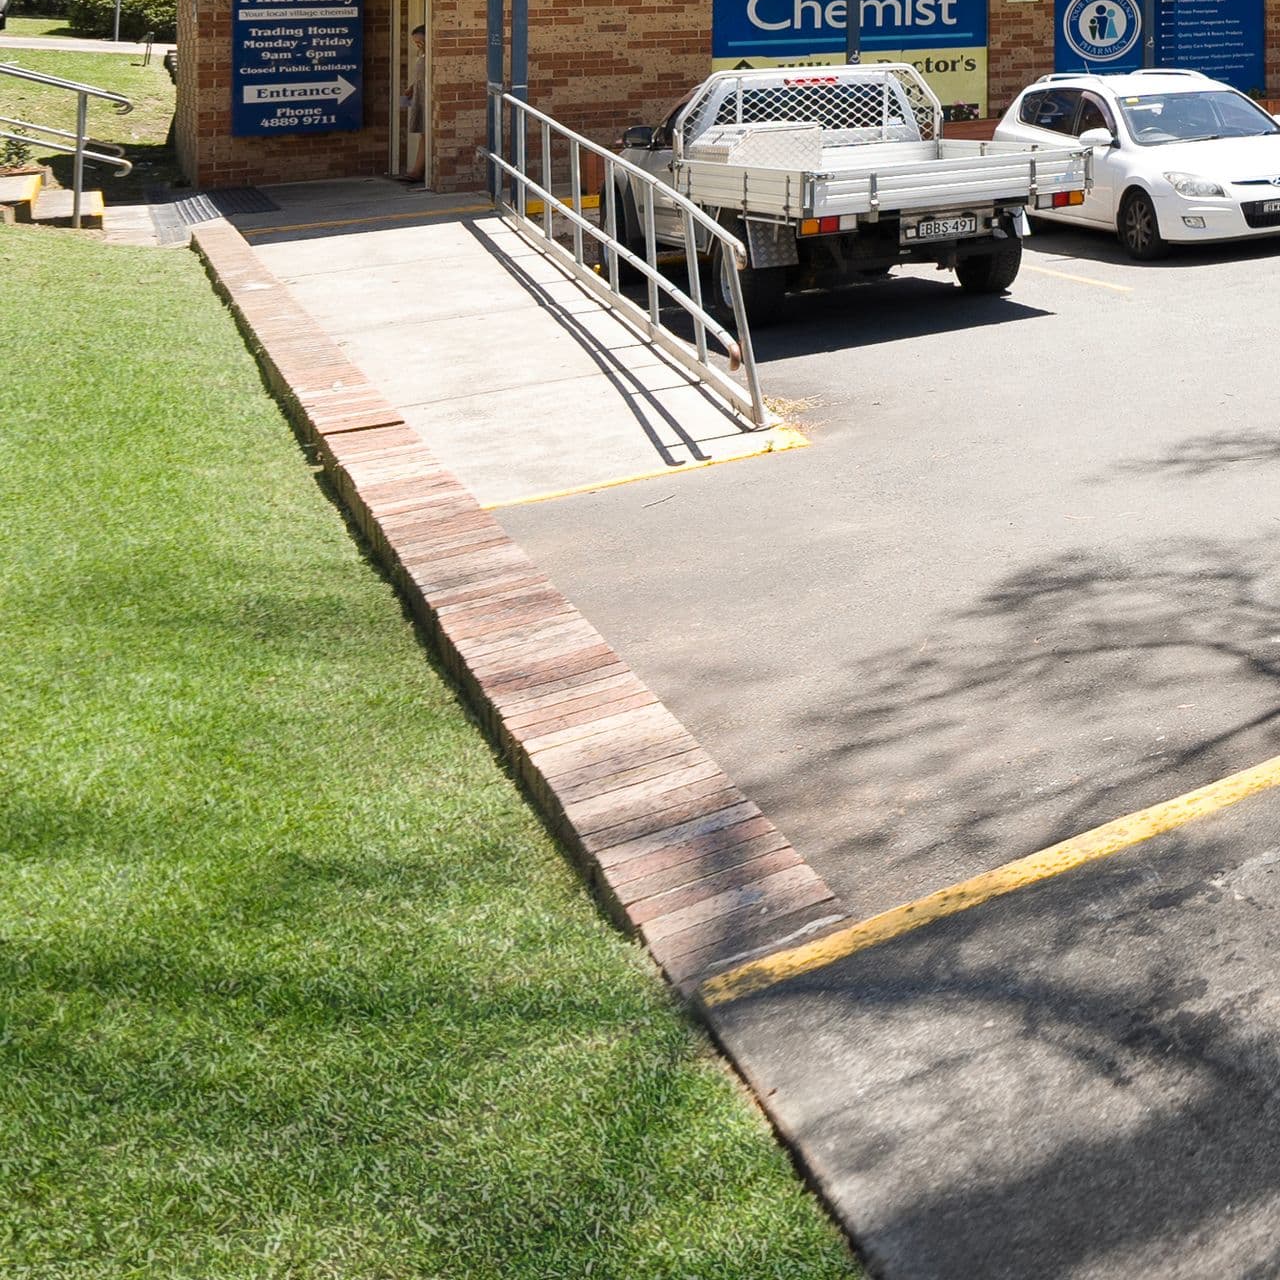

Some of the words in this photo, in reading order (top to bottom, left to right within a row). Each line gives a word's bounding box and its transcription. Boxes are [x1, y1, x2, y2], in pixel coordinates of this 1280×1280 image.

[289, 9, 319, 18] village
[248, 26, 303, 37] Trading
[307, 26, 349, 35] Hours
[243, 39, 298, 49] Monday
[311, 37, 354, 47] Friday
[1079, 38, 1128, 55] PHARMACY
[261, 51, 292, 60] 9am
[305, 49, 337, 59] 6pm
[239, 66, 276, 75] Closed
[279, 65, 311, 73] Public
[314, 63, 357, 72] Holidays
[256, 86, 342, 99] Entrance
[276, 107, 322, 118] Phone
[260, 117, 299, 128] 4889
[302, 115, 337, 126] 9711
